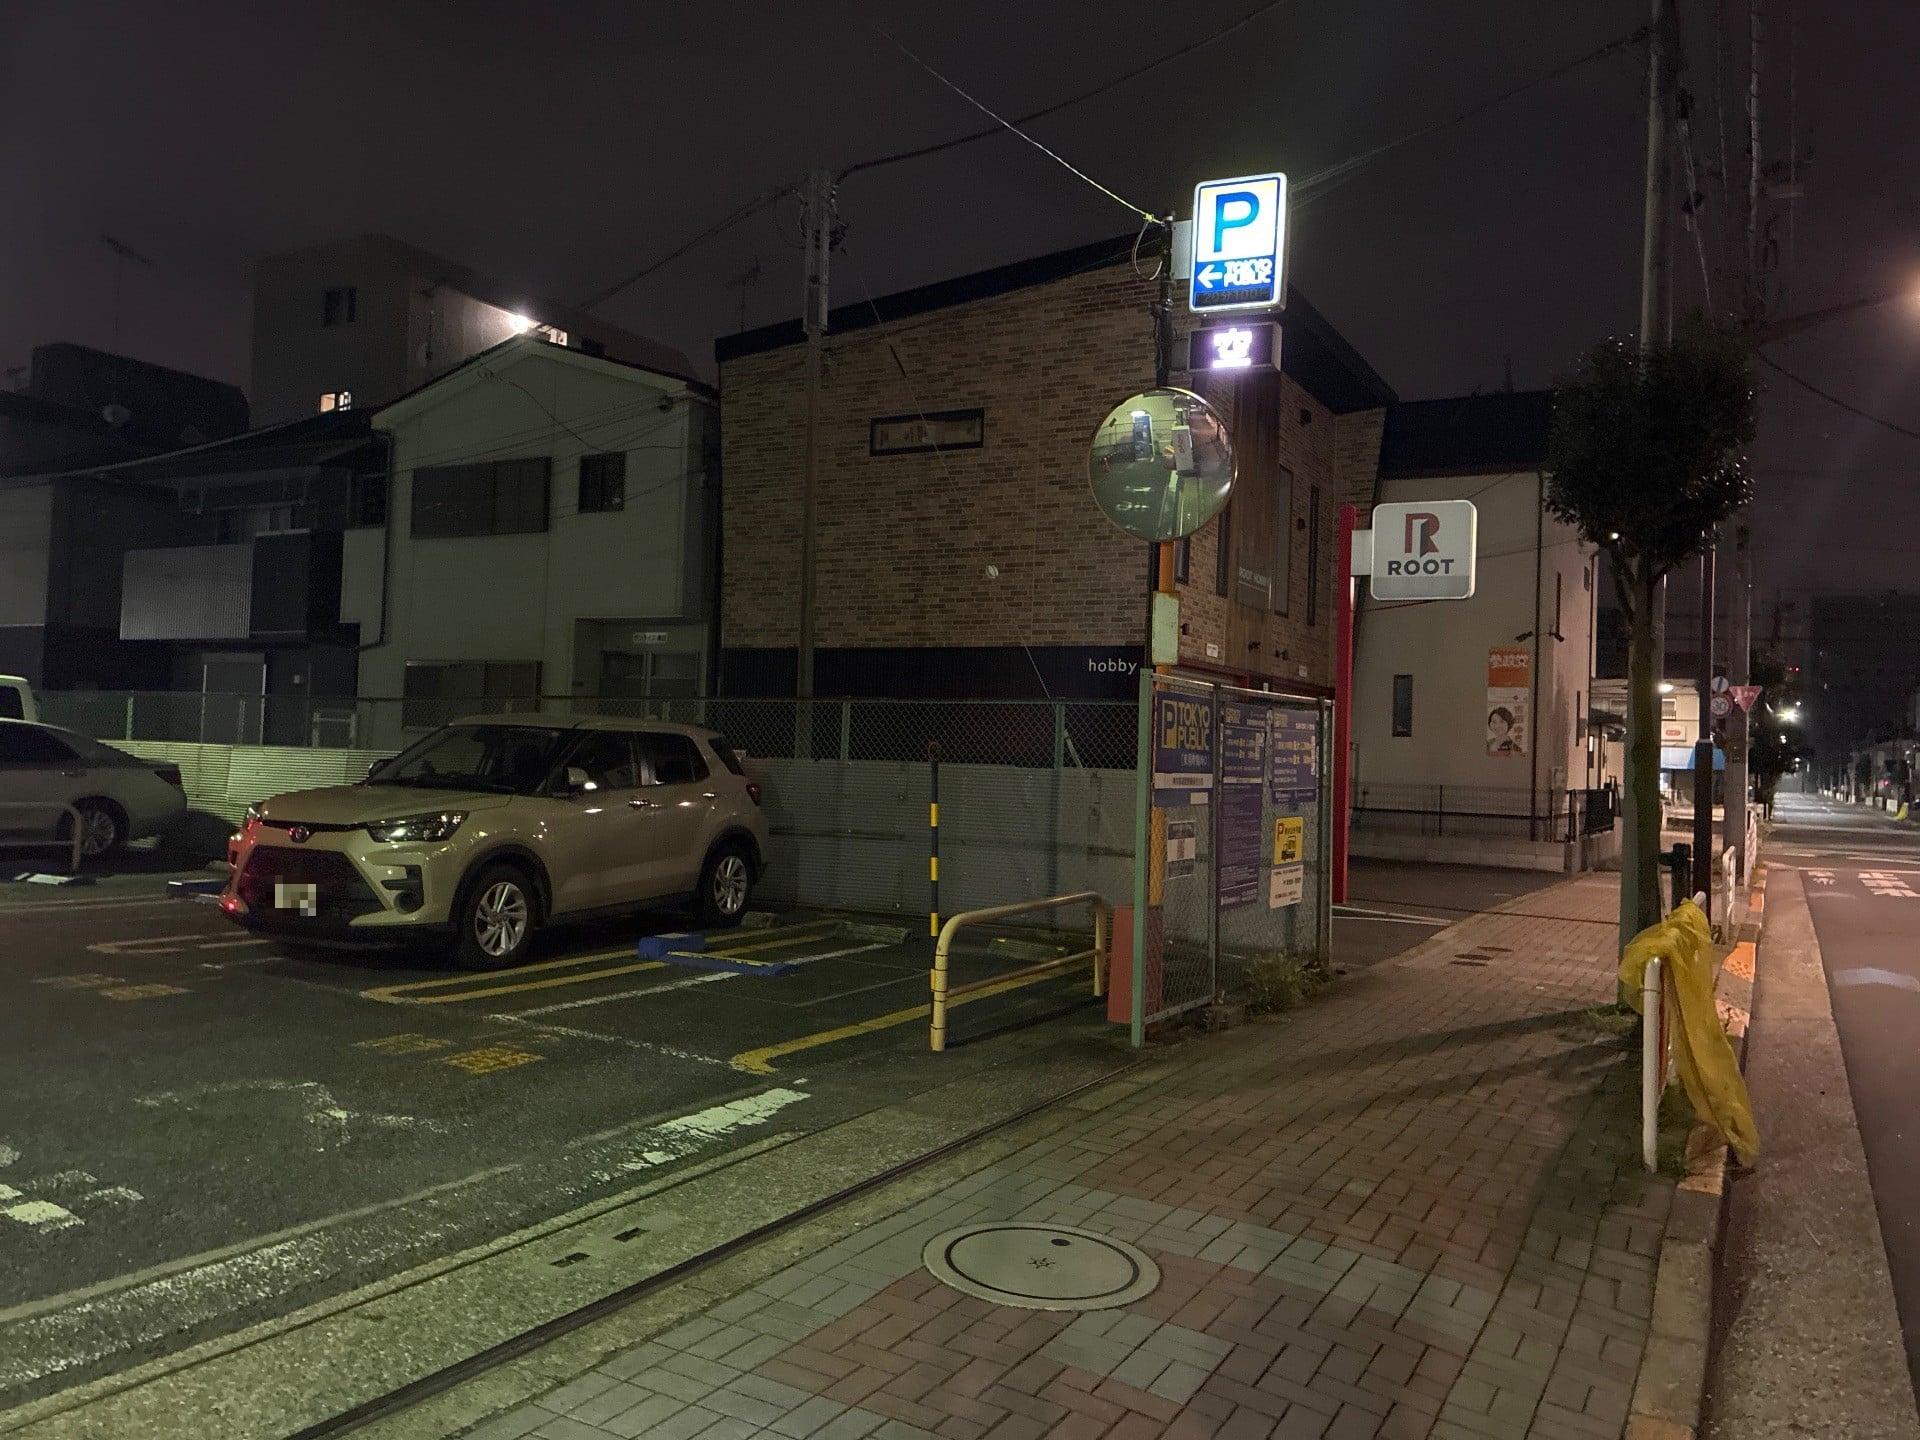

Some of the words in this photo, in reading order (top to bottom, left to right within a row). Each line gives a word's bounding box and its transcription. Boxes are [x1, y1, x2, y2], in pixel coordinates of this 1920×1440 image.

[1213, 191, 1260, 253] P
[1387, 558, 1455, 576] ROOT
[1088, 657, 1138, 676] hobby
[1177, 701, 1211, 728] TOKYO
[1712, 700, 1728, 712] 30
[1177, 725, 1211, 751] PUBLIC
